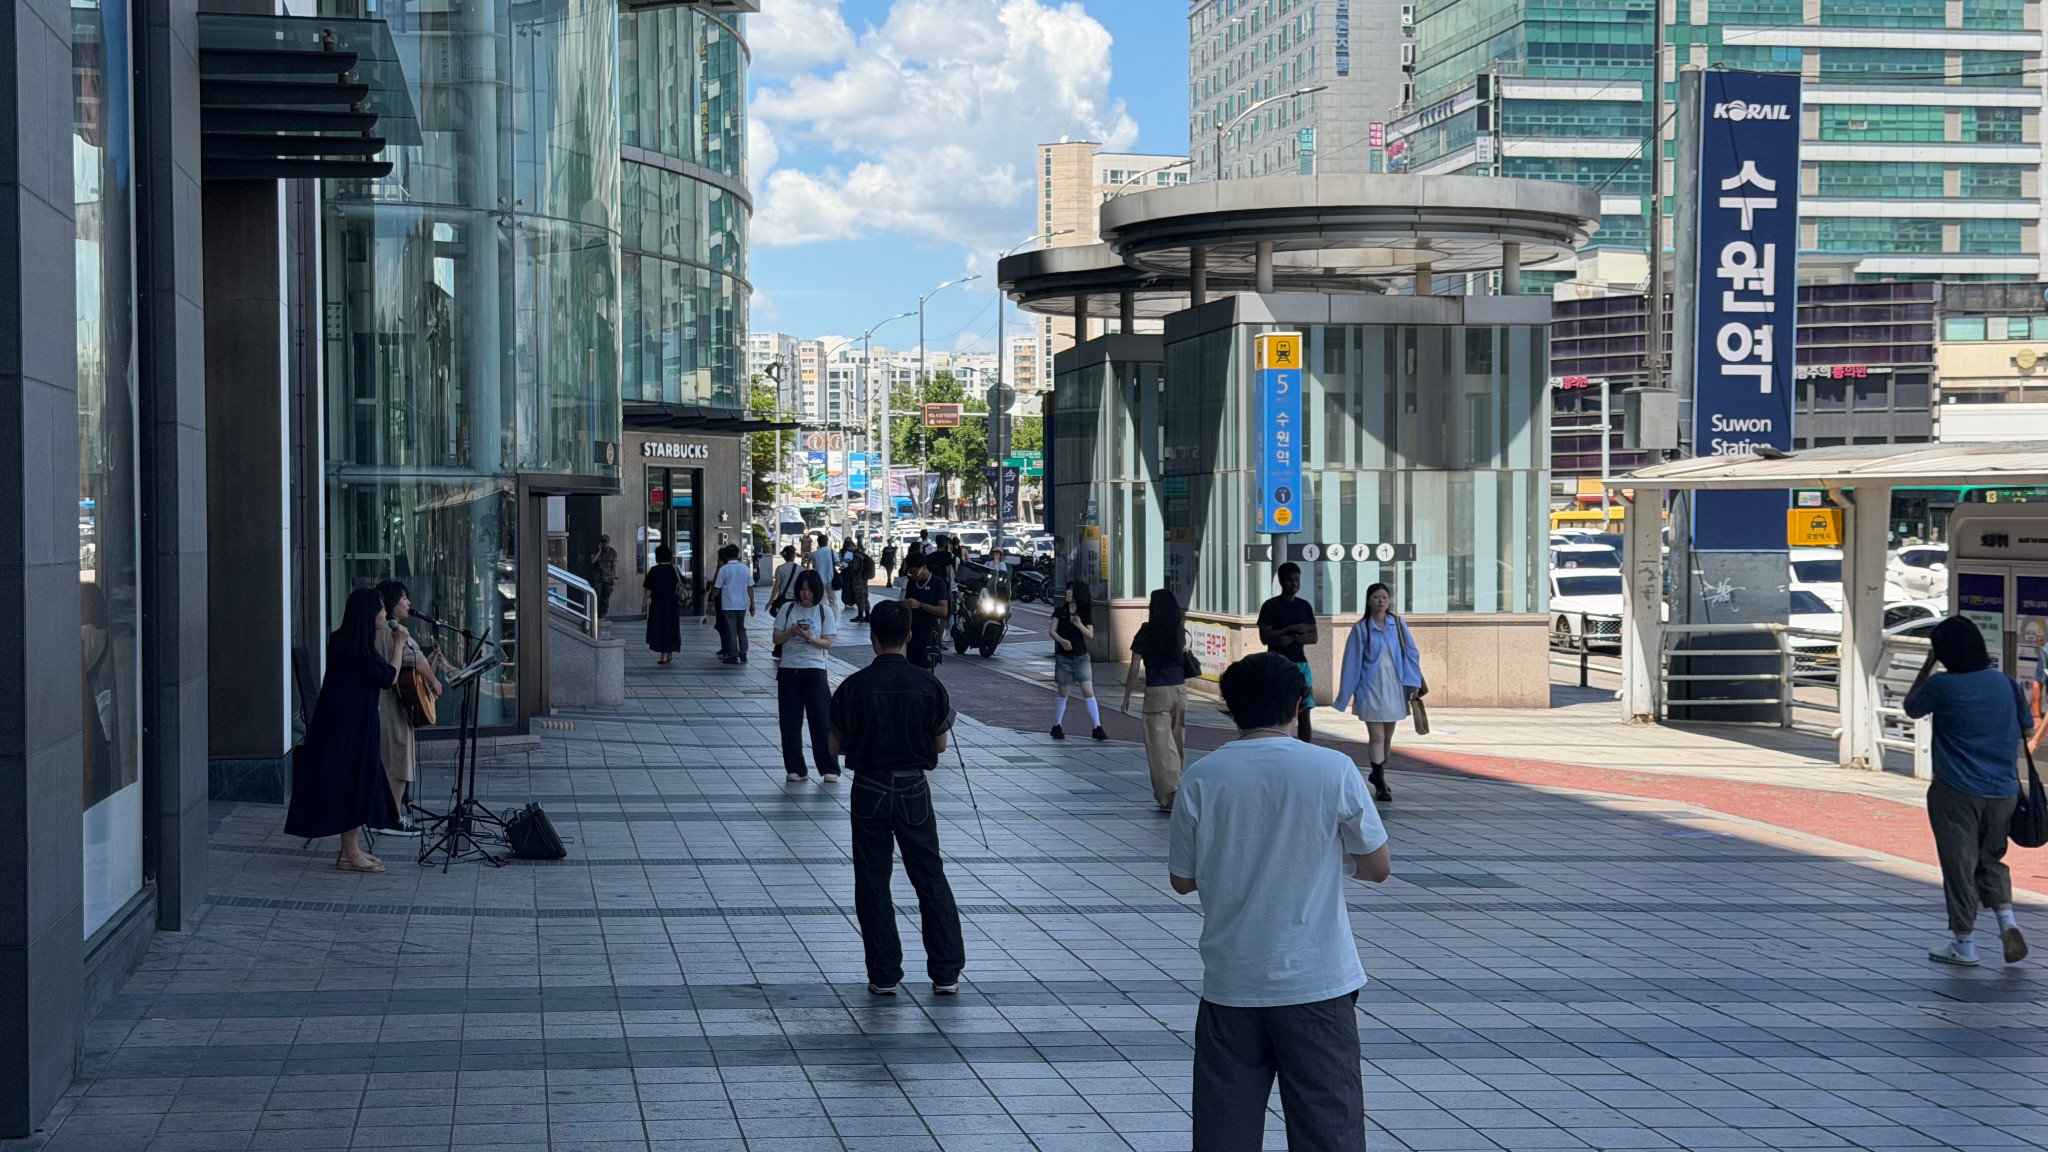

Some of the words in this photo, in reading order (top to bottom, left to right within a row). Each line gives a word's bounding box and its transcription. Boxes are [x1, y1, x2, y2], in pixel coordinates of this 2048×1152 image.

[1717, 161, 1777, 393] 수원역
[1277, 374, 1289, 394] 5
[1711, 414, 1771, 432] Suwon
[1276, 411, 1290, 467] 수원역
[644, 441, 708, 459] STARBUCKS
[722, 533, 729, 545] R
